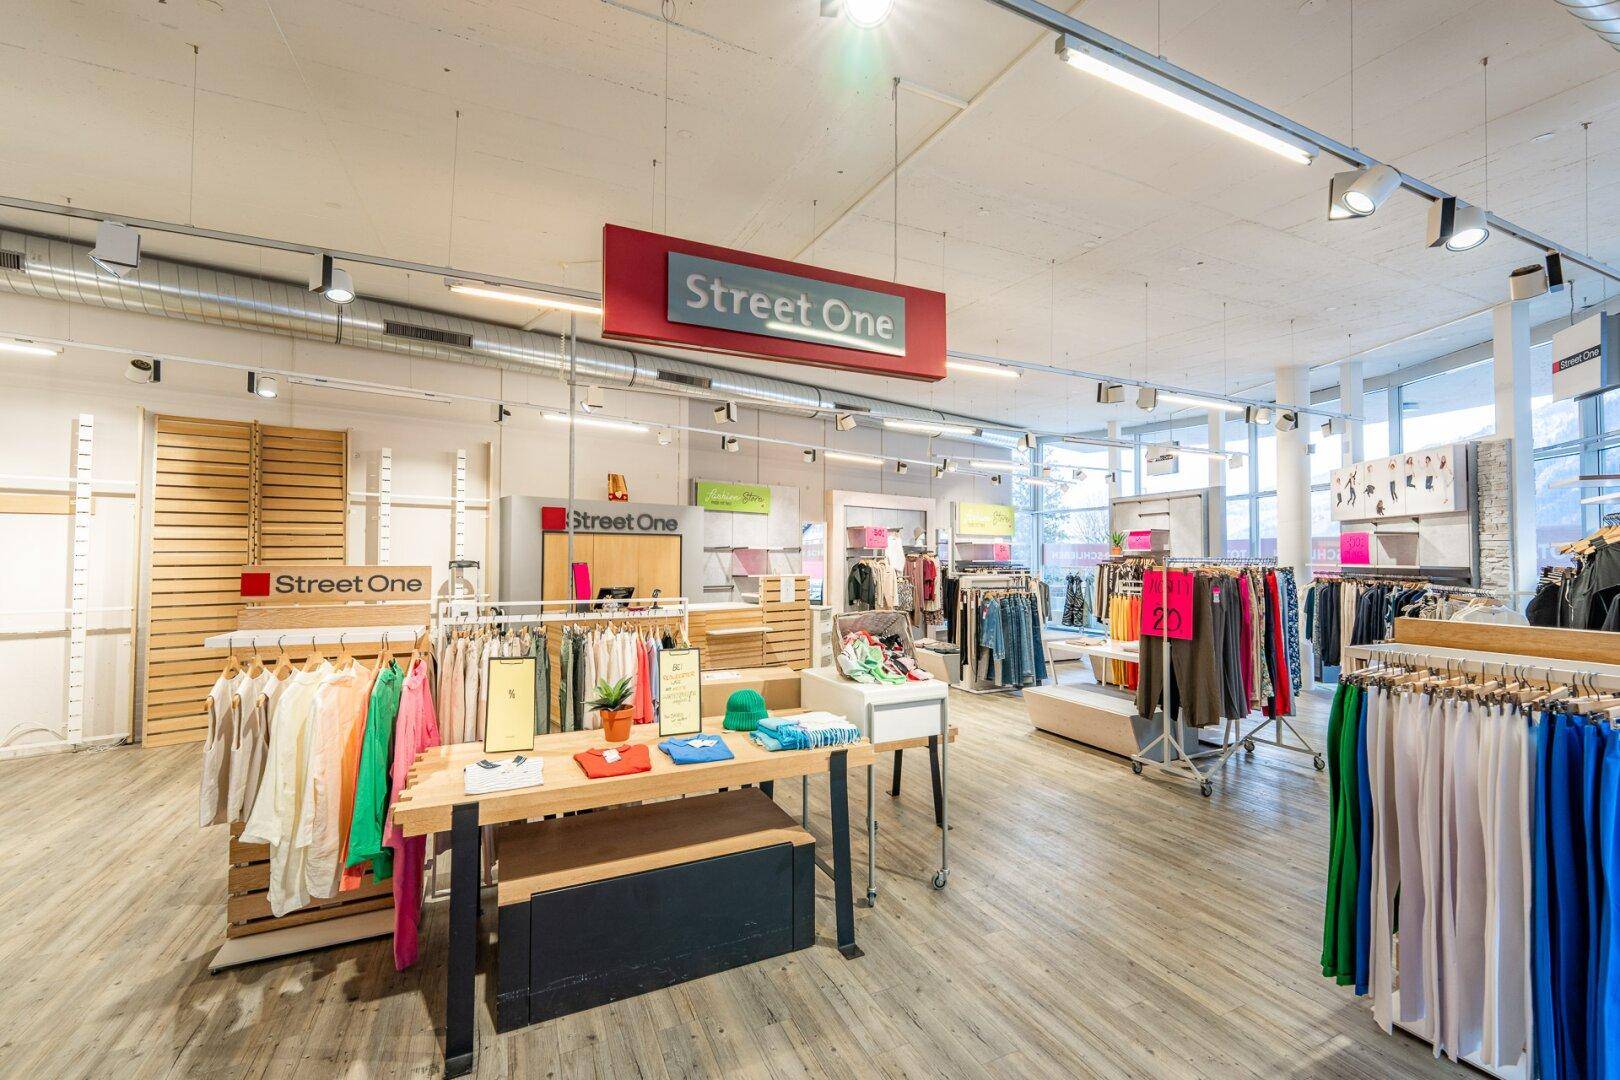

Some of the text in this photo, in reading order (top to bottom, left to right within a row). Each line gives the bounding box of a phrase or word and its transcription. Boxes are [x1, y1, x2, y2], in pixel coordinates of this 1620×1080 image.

[685, 273, 895, 340] Street One
[1560, 348, 1600, 370] Street One
[742, 491, 765, 505] Store
[566, 510, 679, 531] Street One
[275, 574, 423, 594] Street One
